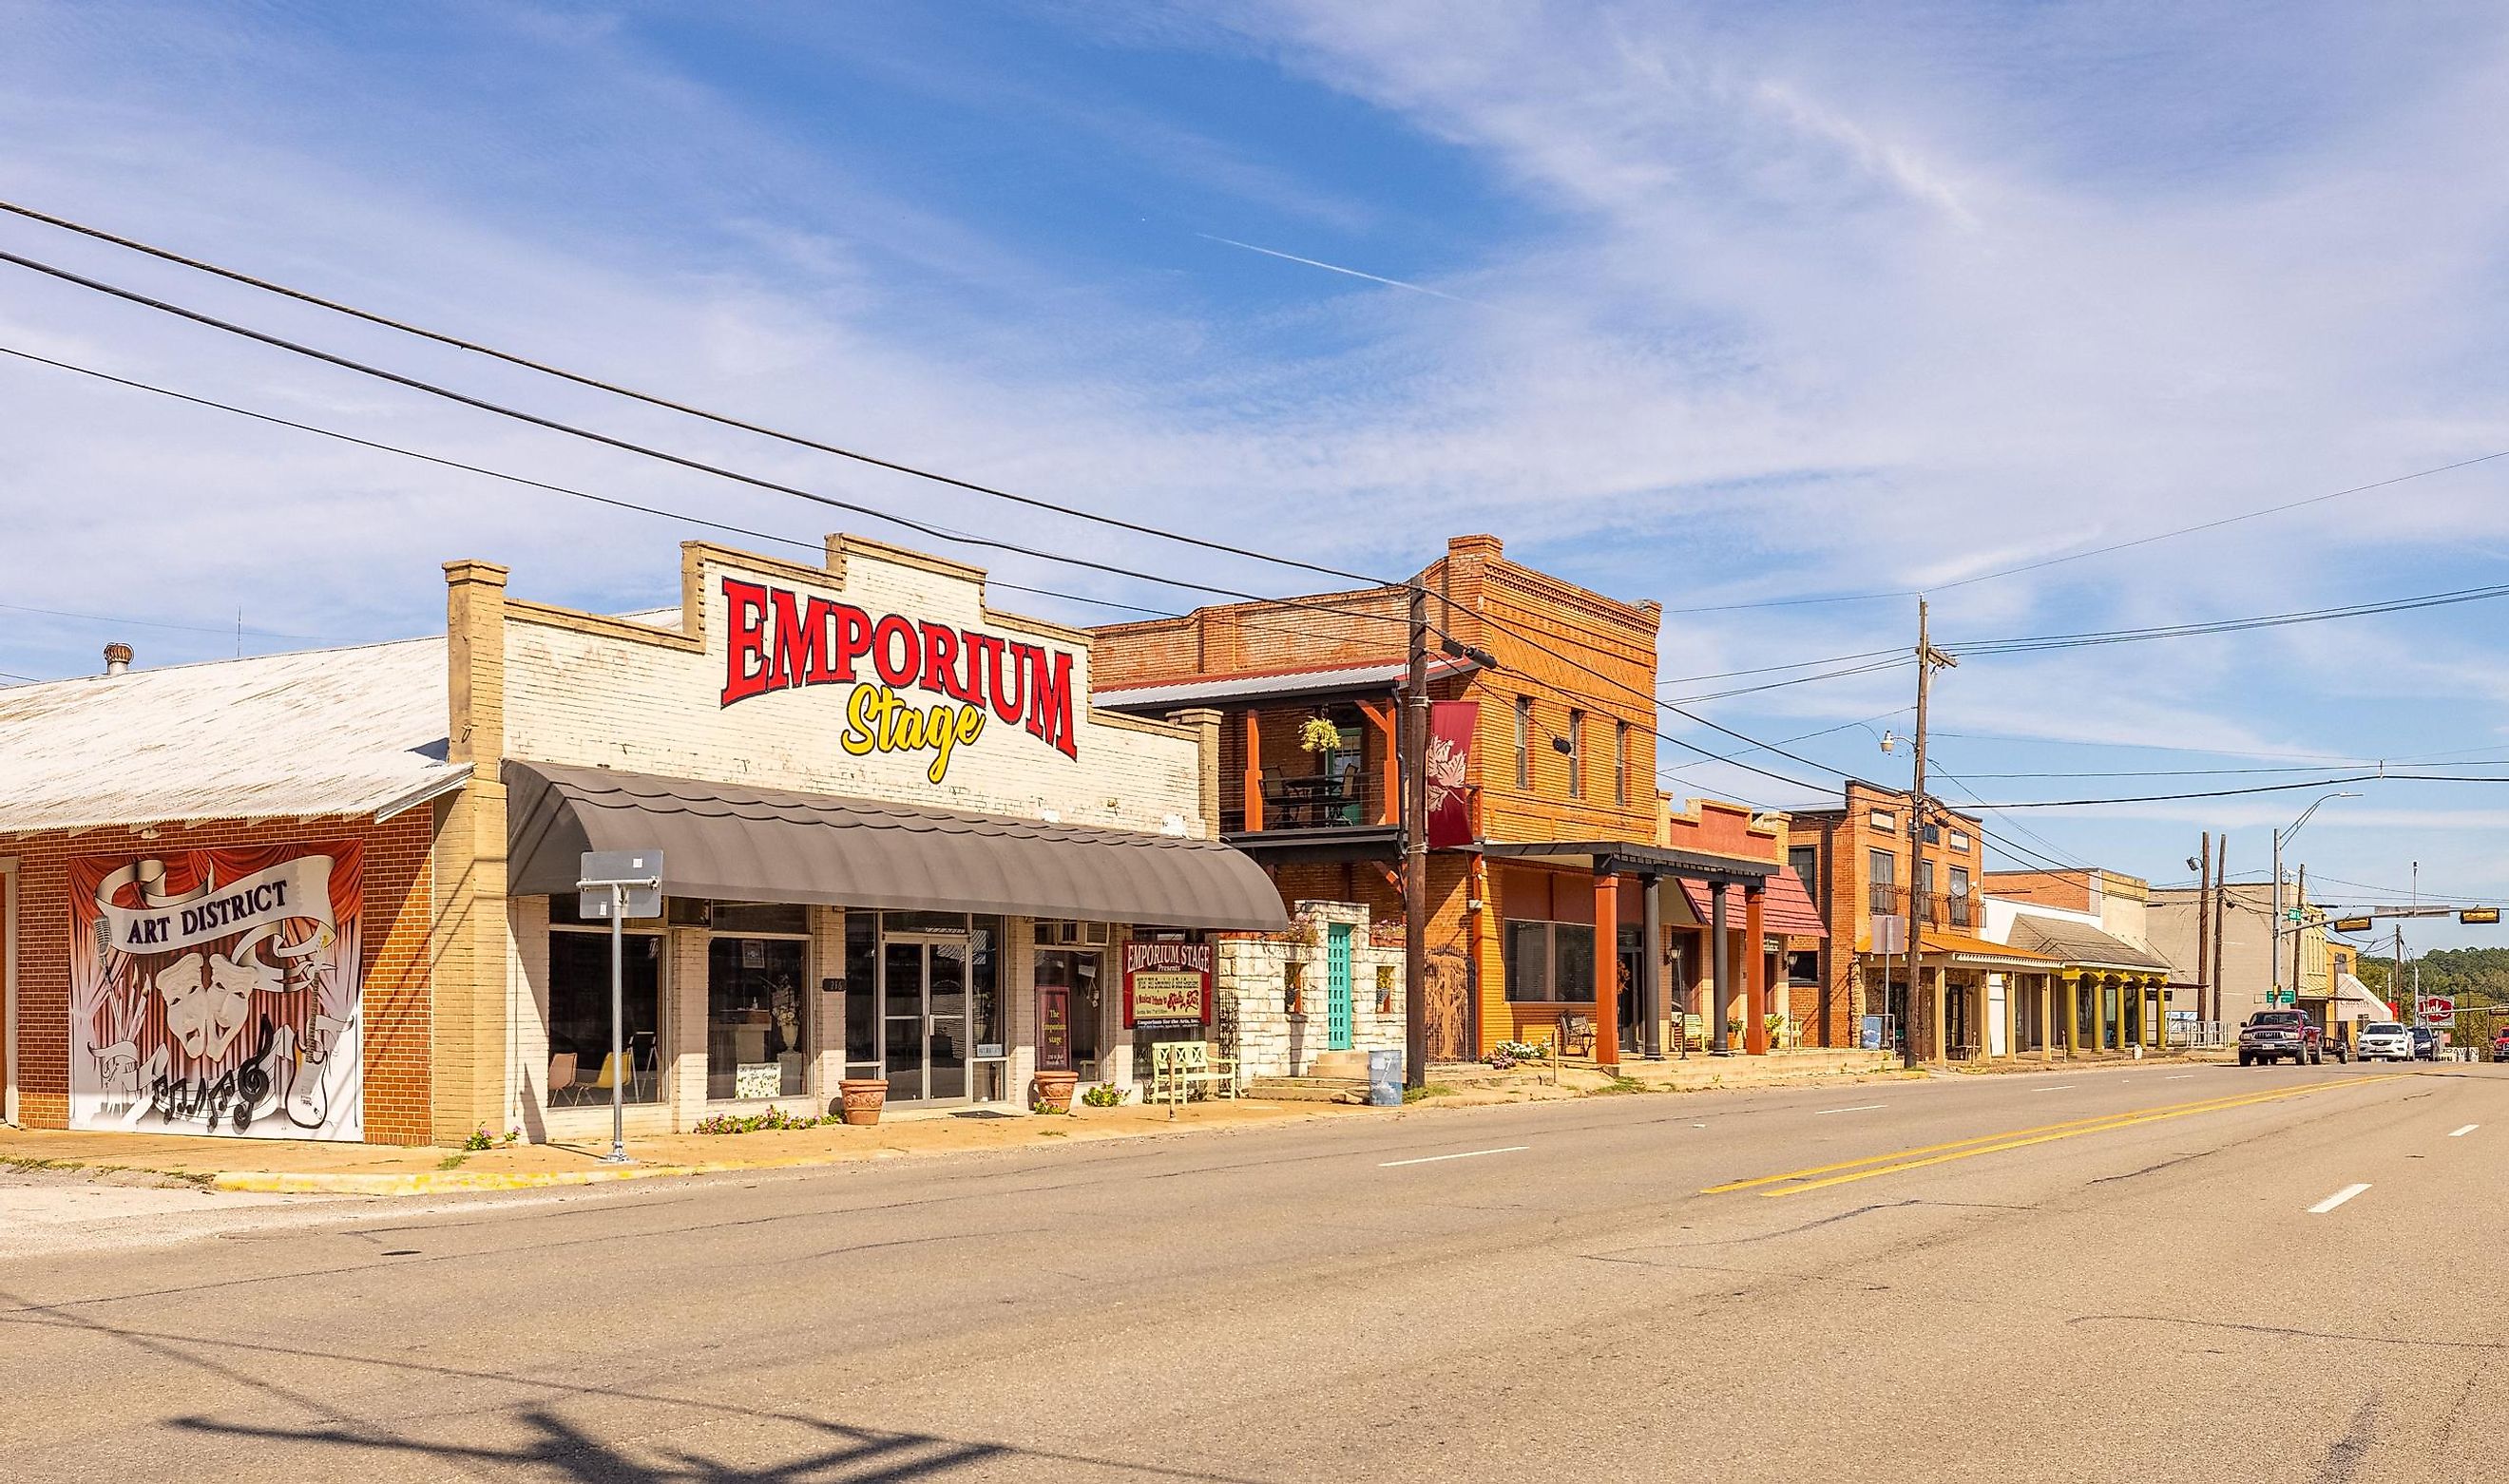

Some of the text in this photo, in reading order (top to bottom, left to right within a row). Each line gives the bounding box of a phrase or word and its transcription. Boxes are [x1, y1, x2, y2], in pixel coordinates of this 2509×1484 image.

[720, 576, 1078, 763] EMPORIUM
[840, 682, 986, 784] Stage
[127, 880, 287, 944] ART DISTRICT
[1127, 944, 1210, 974] EMPORIUM STAGE
[1158, 963, 1180, 972] Presents
